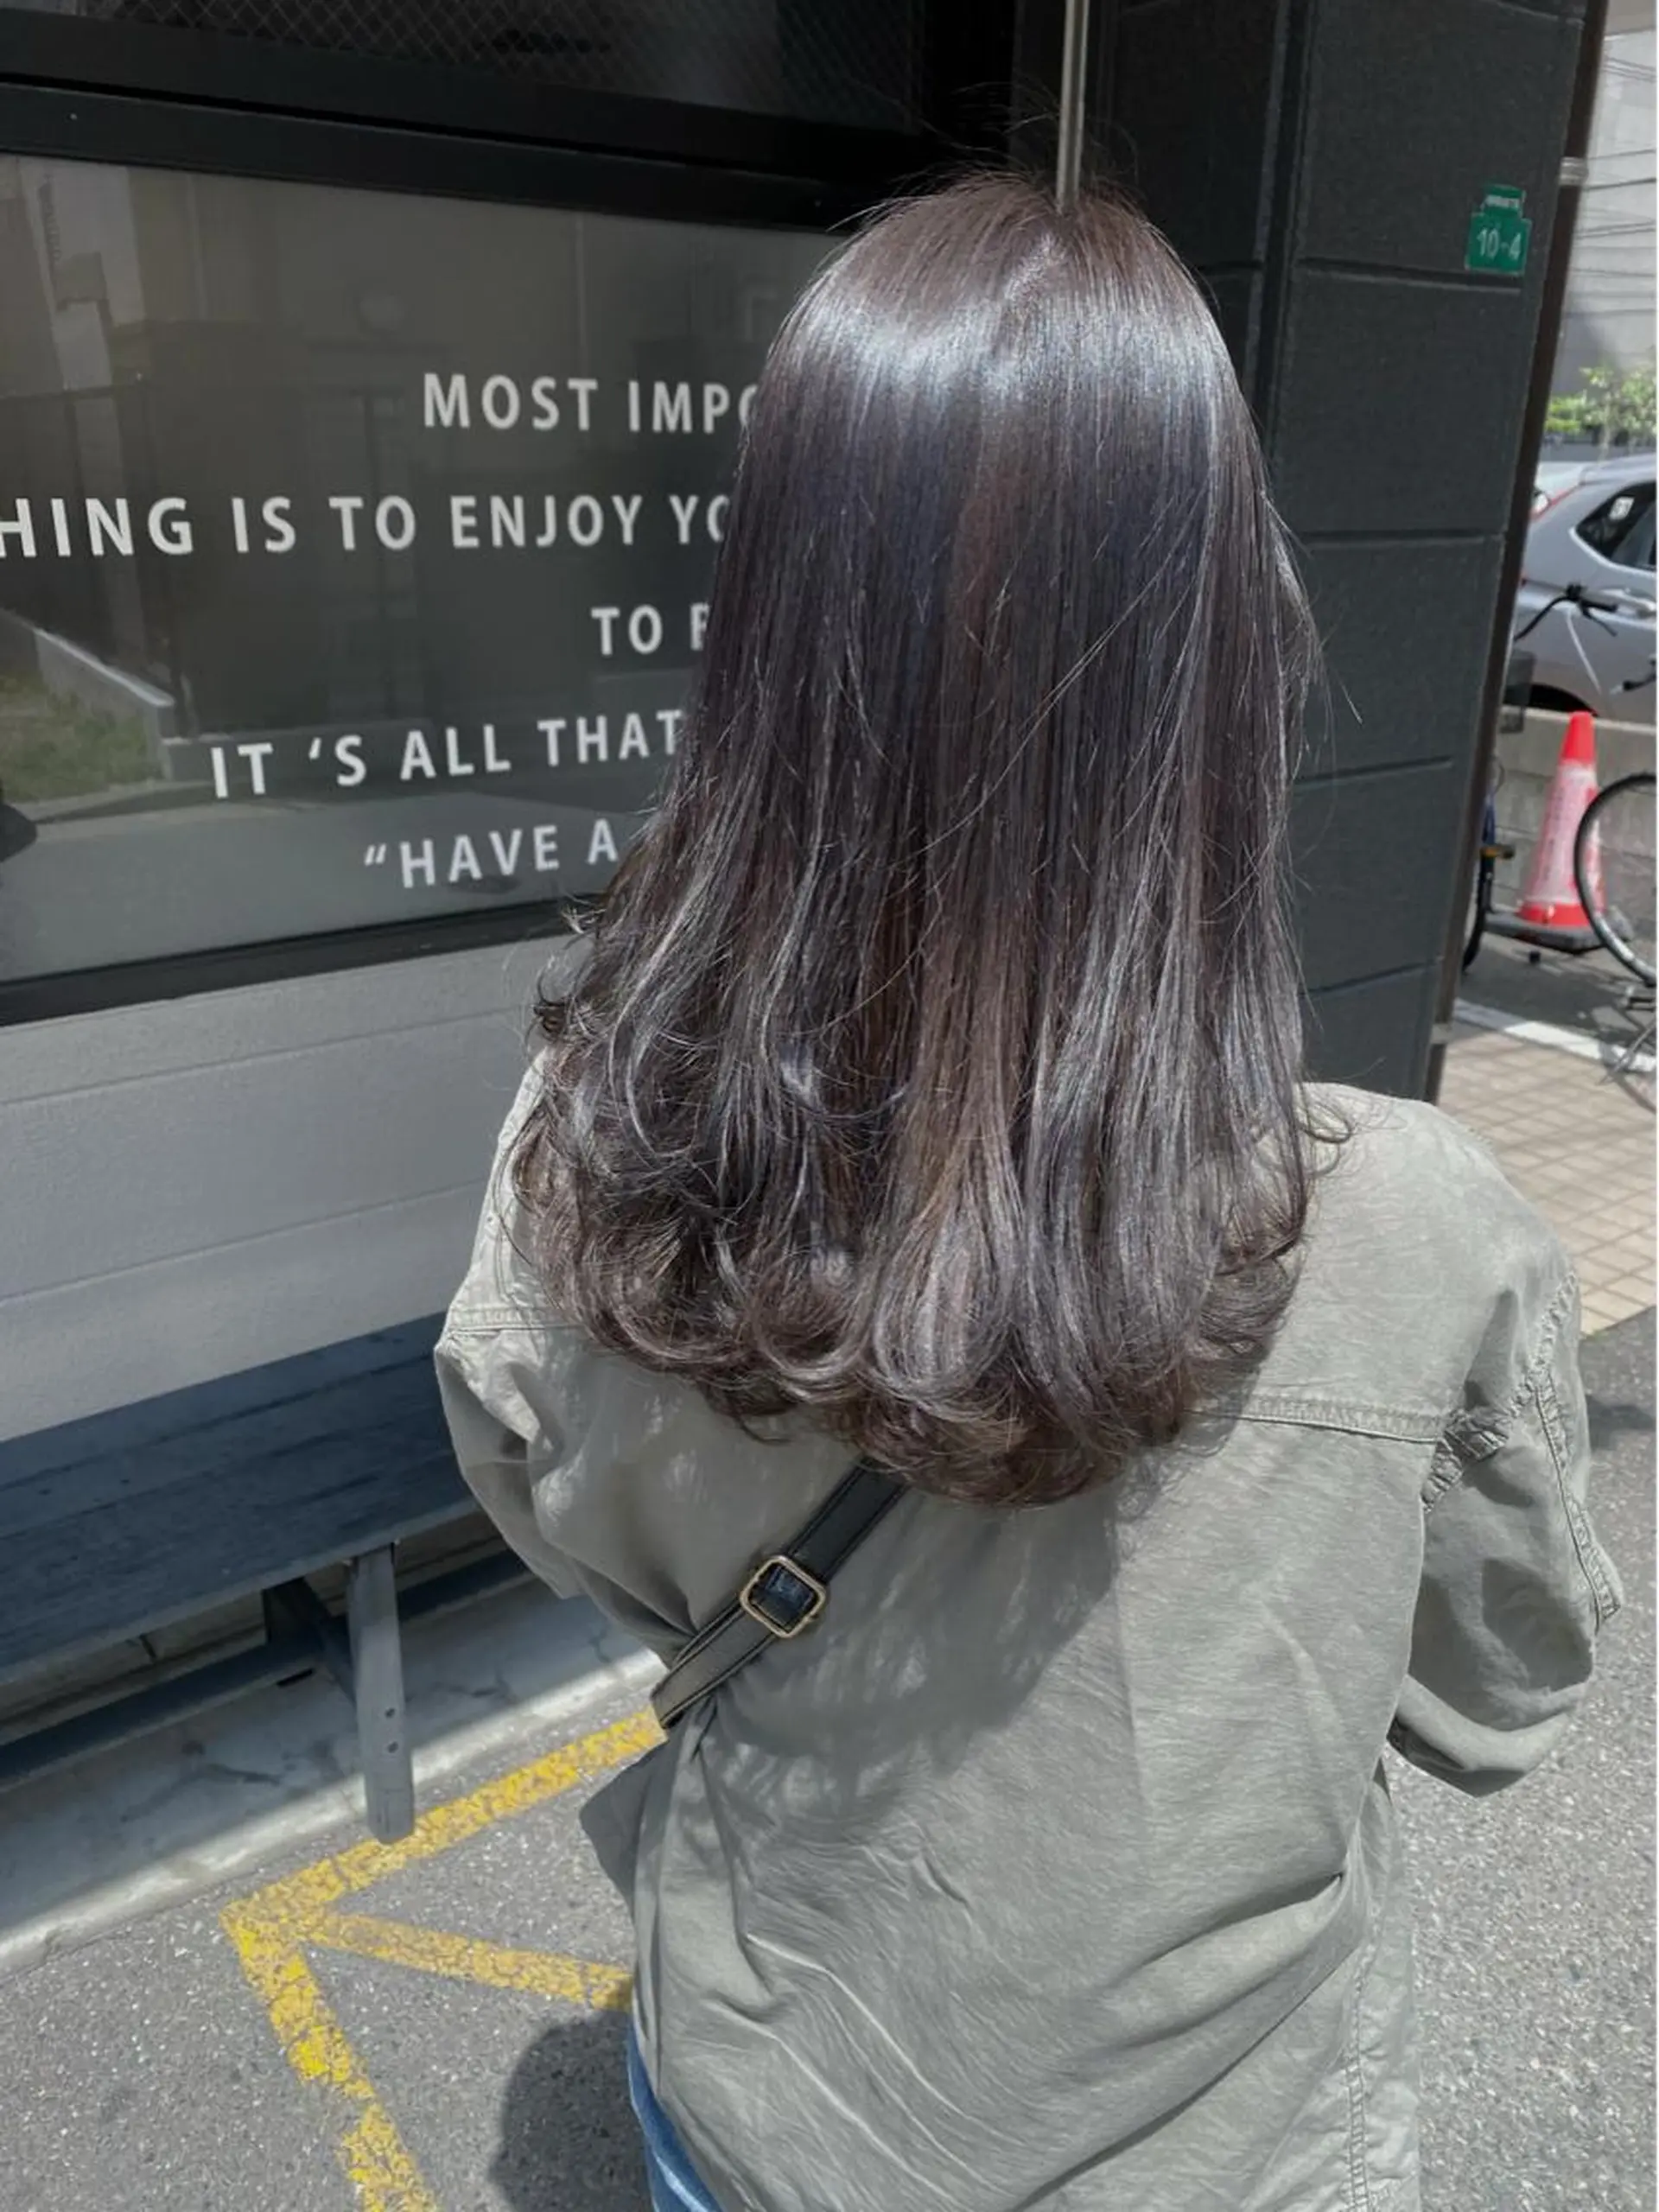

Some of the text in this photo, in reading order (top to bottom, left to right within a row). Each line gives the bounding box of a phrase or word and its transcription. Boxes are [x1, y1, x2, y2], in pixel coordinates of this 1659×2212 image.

[1476, 227, 1522, 259] 10-4
[424, 373, 598, 429] MOST
[232, 496, 296, 553] IS
[329, 495, 416, 550] TO
[450, 495, 642, 547] ENJOY
[591, 605, 663, 655] TO
[211, 743, 273, 798] IT
[400, 724, 512, 779] ALL
[537, 709, 682, 766] THAT
[588, 818, 618, 864] A
